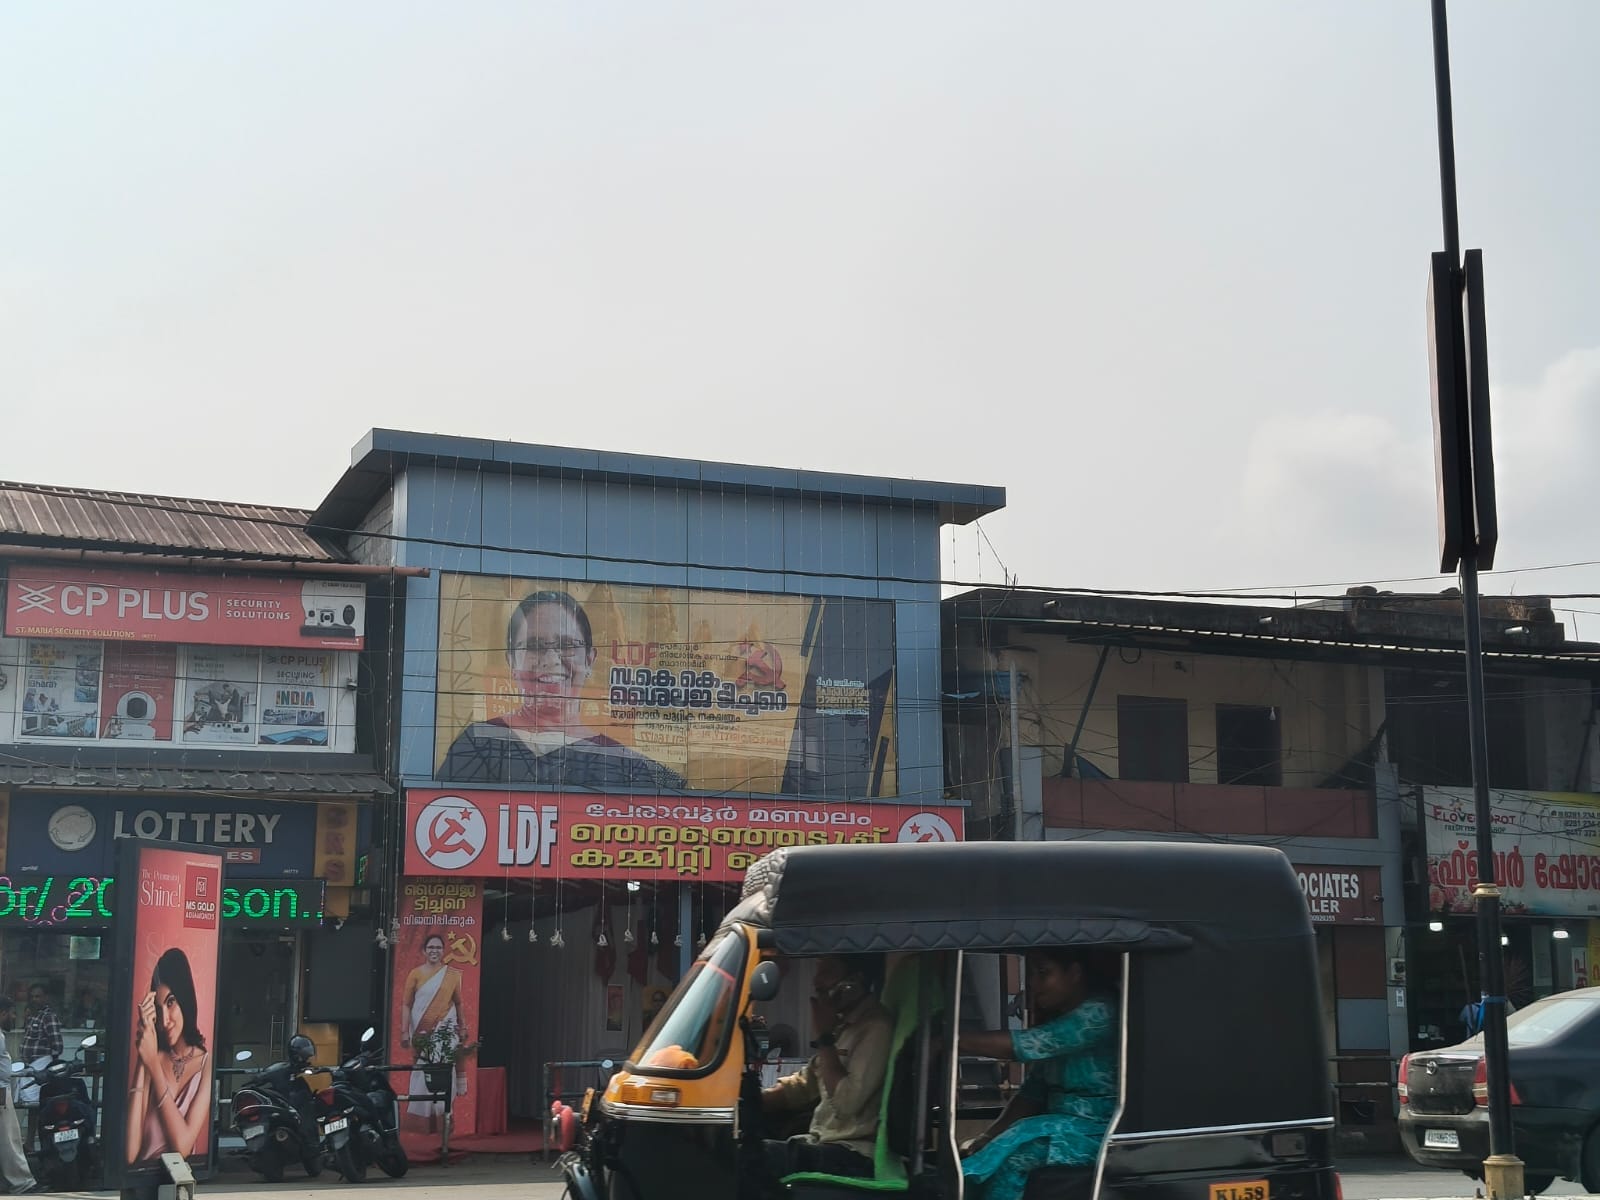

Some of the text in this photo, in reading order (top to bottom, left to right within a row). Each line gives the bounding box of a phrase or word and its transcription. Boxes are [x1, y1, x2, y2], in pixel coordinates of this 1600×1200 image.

[61, 585, 209, 621] CP PLUS
[226, 599, 281, 608] SECURITY
[226, 610, 291, 620] SOLUTIONS
[55, 627, 91, 636] SECURITY
[93, 629, 136, 638] SOLUTIONS
[281, 655, 295, 665] CP
[611, 640, 659, 666] LDF
[276, 690, 315, 706] INDIA
[610, 685, 712, 708] ശൈലജ
[716, 681, 789, 716] ടീച്ചറെ
[585, 804, 872, 826] പേരാവൂർ മണ്ഡലം
[114, 810, 281, 843] LOTTERY
[497, 804, 558, 866] LDF
[570, 845, 711, 875] കമ്മിറ്റി
[140, 880, 182, 908] Shine!
[404, 884, 477, 898] ശൈലജ
[185, 901, 215, 912] MS GOLD
[414, 895, 466, 914] ടീച്ചറെ
[1310, 899, 1340, 913] LER
[403, 914, 476, 927] വിജയിപ്പിക്കുക
